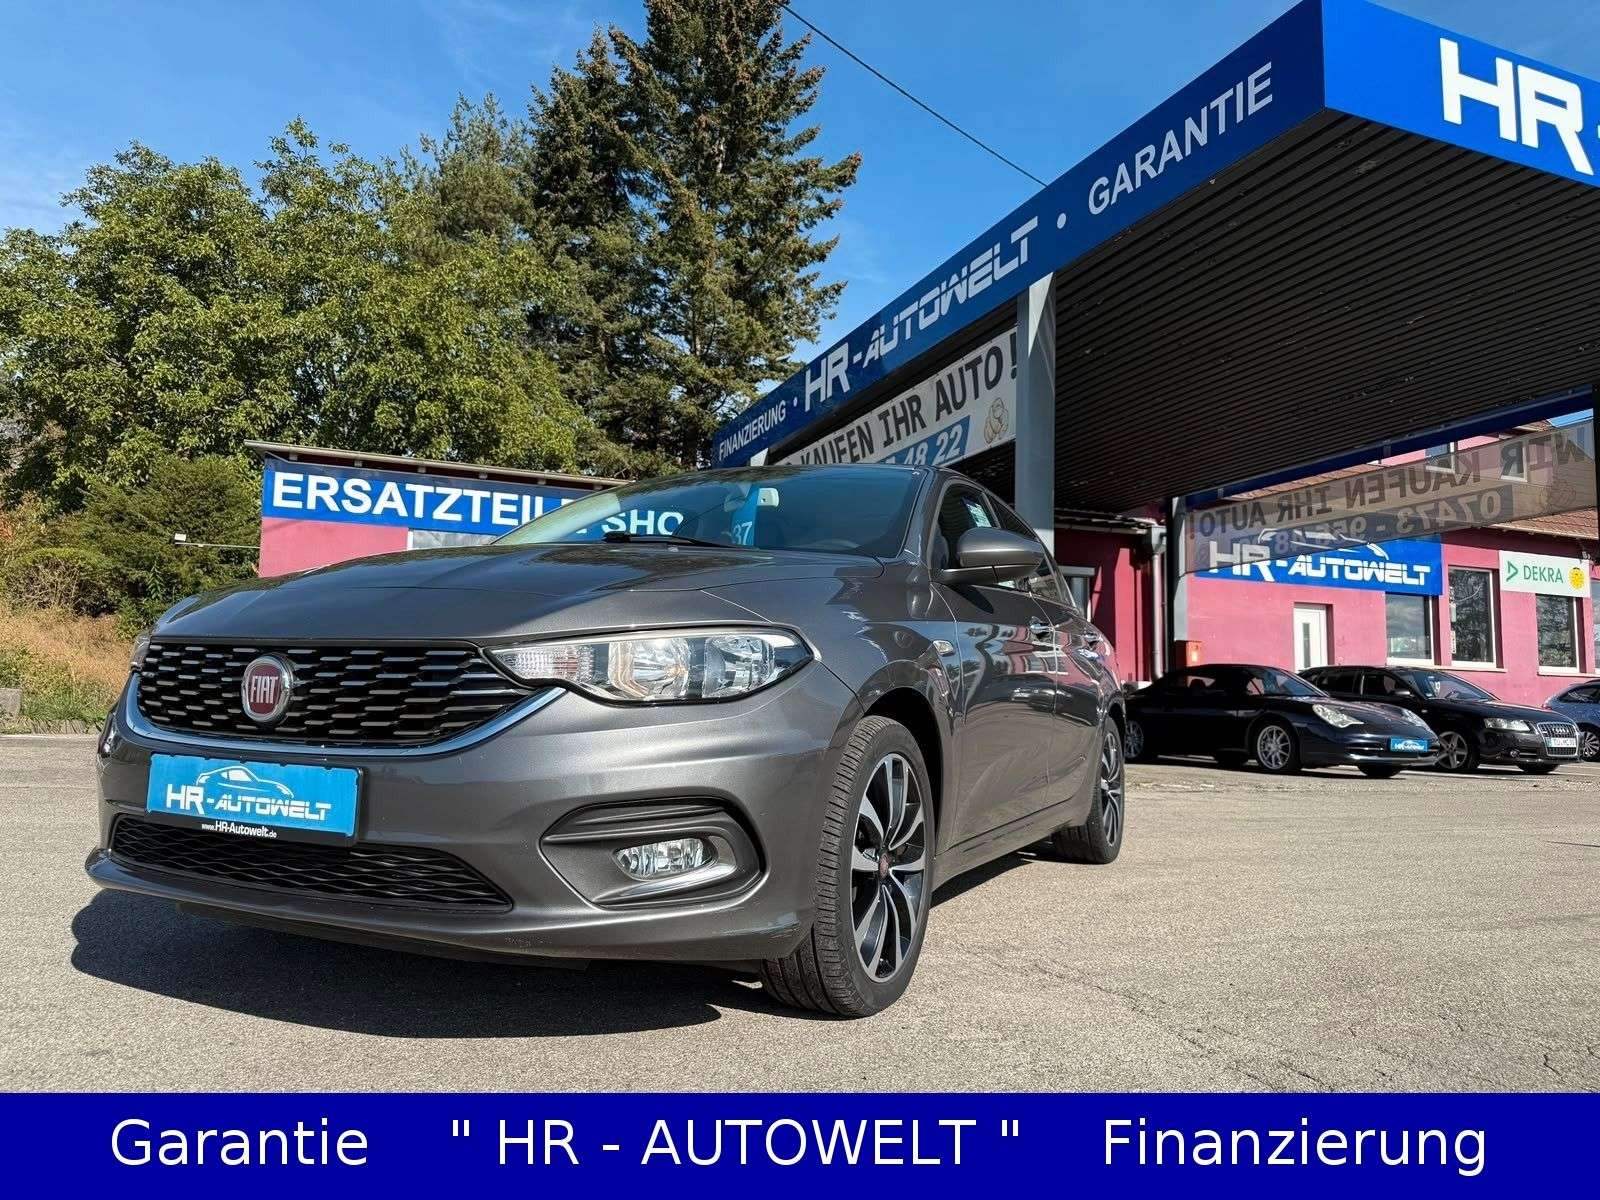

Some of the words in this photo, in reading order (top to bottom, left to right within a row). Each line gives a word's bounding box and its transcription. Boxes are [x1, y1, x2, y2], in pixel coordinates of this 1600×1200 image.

[1440, 37, 1600, 176] HR
[718, 400, 787, 461] FINANZIERUNG
[1088, 62, 1273, 215] GARANTIE
[878, 394, 927, 448] IHR
[932, 424, 963, 466] 22
[601, 509, 685, 536] SHO
[1523, 565, 1564, 583] DEKRA
[250, 675, 279, 704] FIAT
[201, 820, 277, 839] www.HR-Autowelt.de
